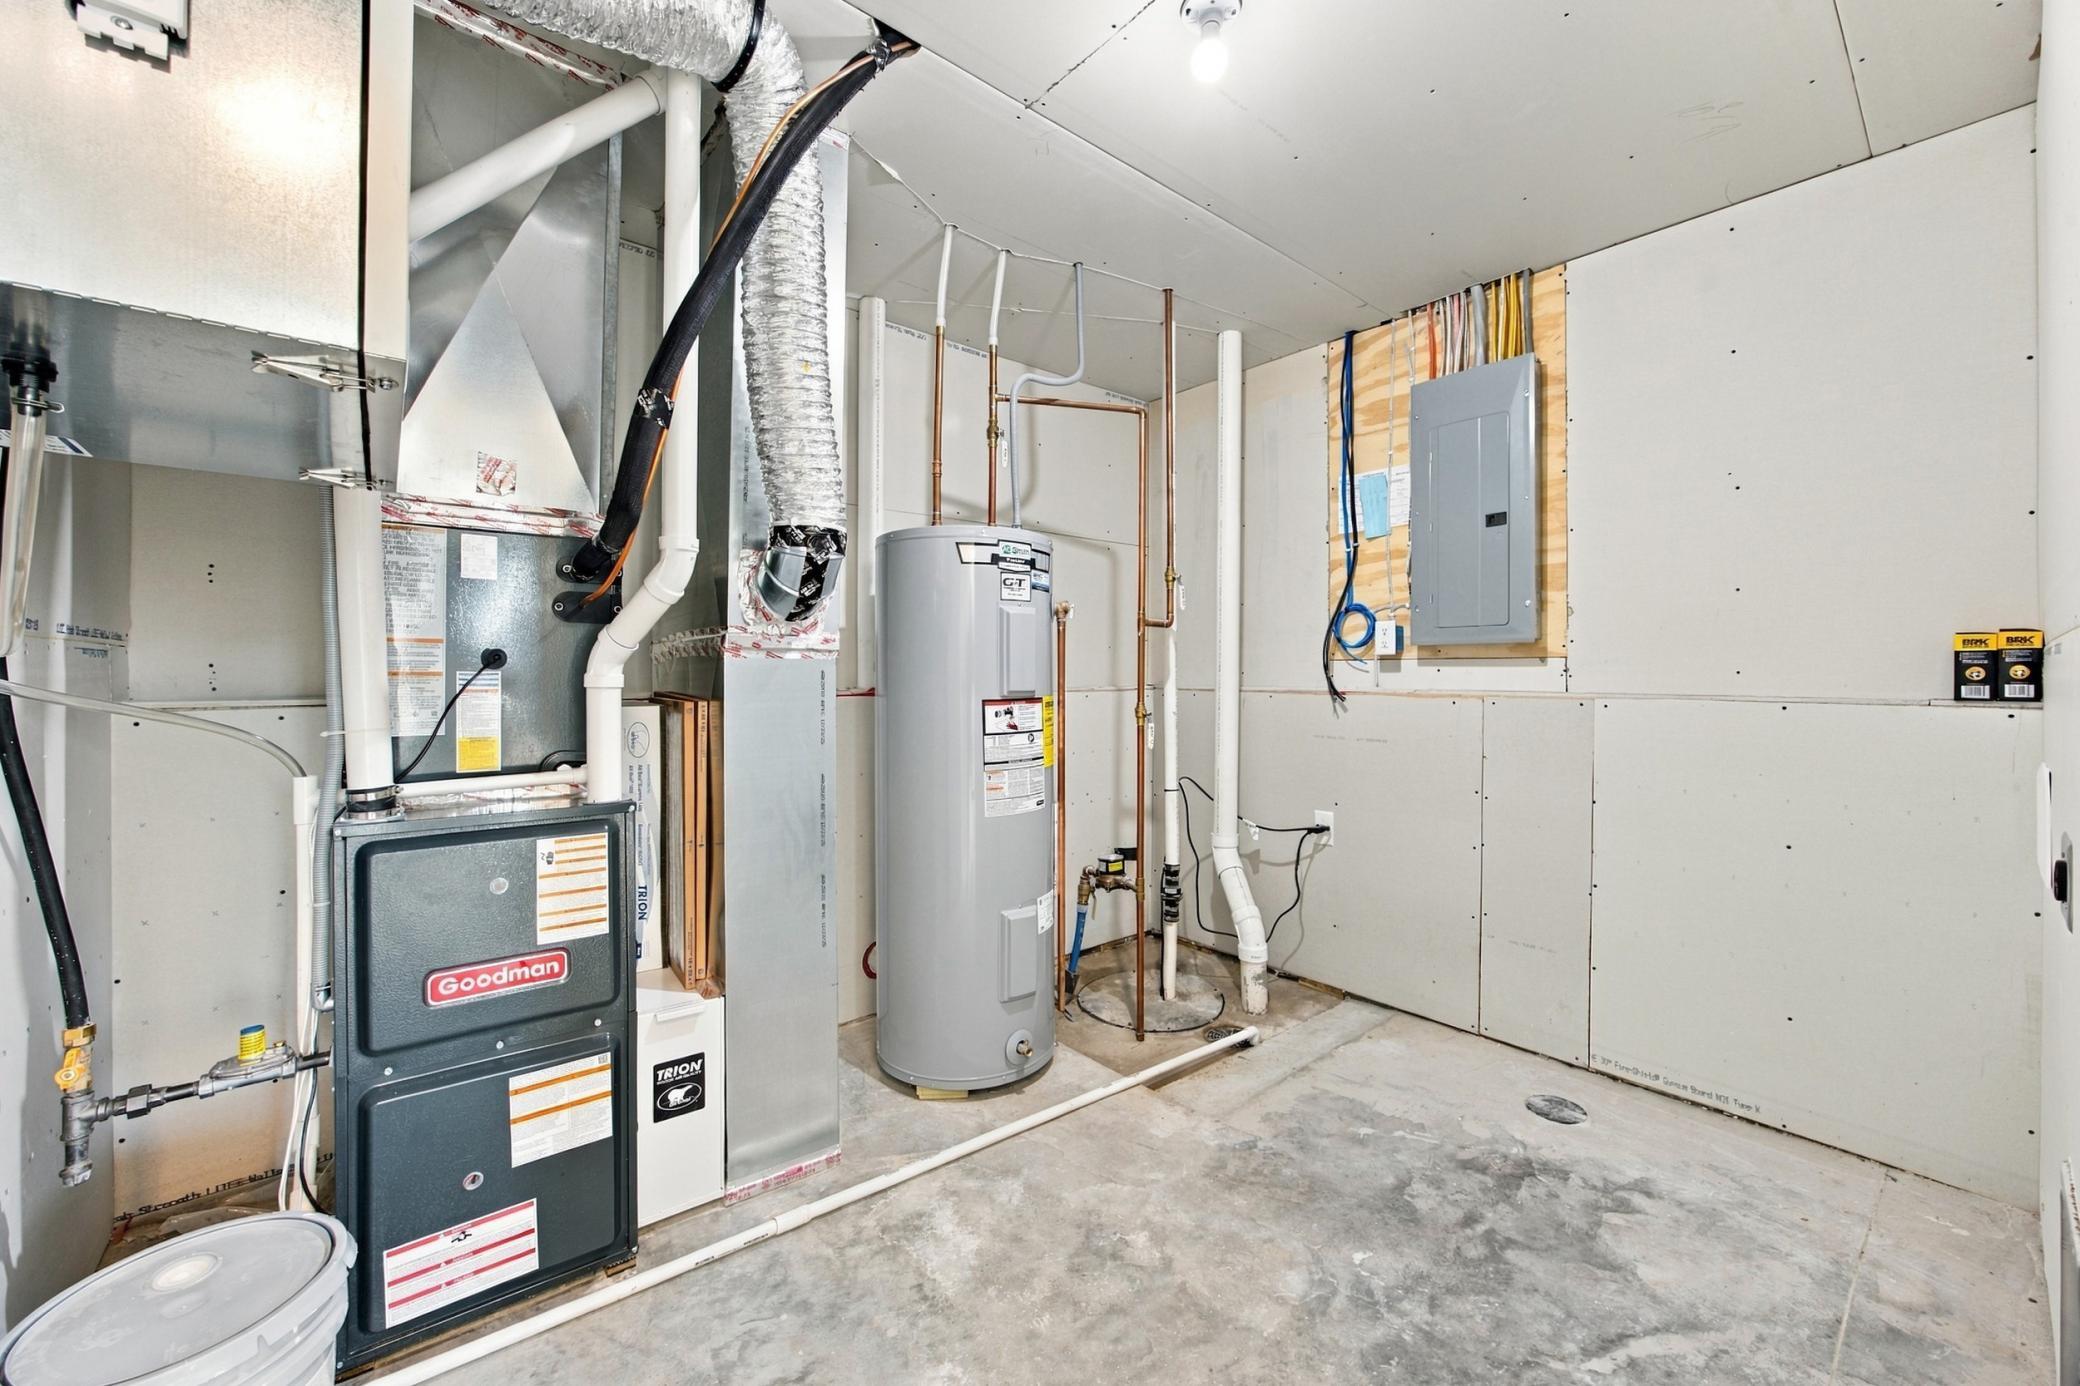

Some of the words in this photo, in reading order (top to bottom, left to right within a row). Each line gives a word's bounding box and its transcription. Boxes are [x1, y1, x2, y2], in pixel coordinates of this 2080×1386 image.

[1962, 638, 1990, 646] BRK
[2006, 636, 2035, 644] BRK
[637, 885, 648, 921] TRION
[438, 961, 560, 995] Goodman
[657, 1059, 703, 1081] TRION
[1690, 1084, 1713, 1099] Board
